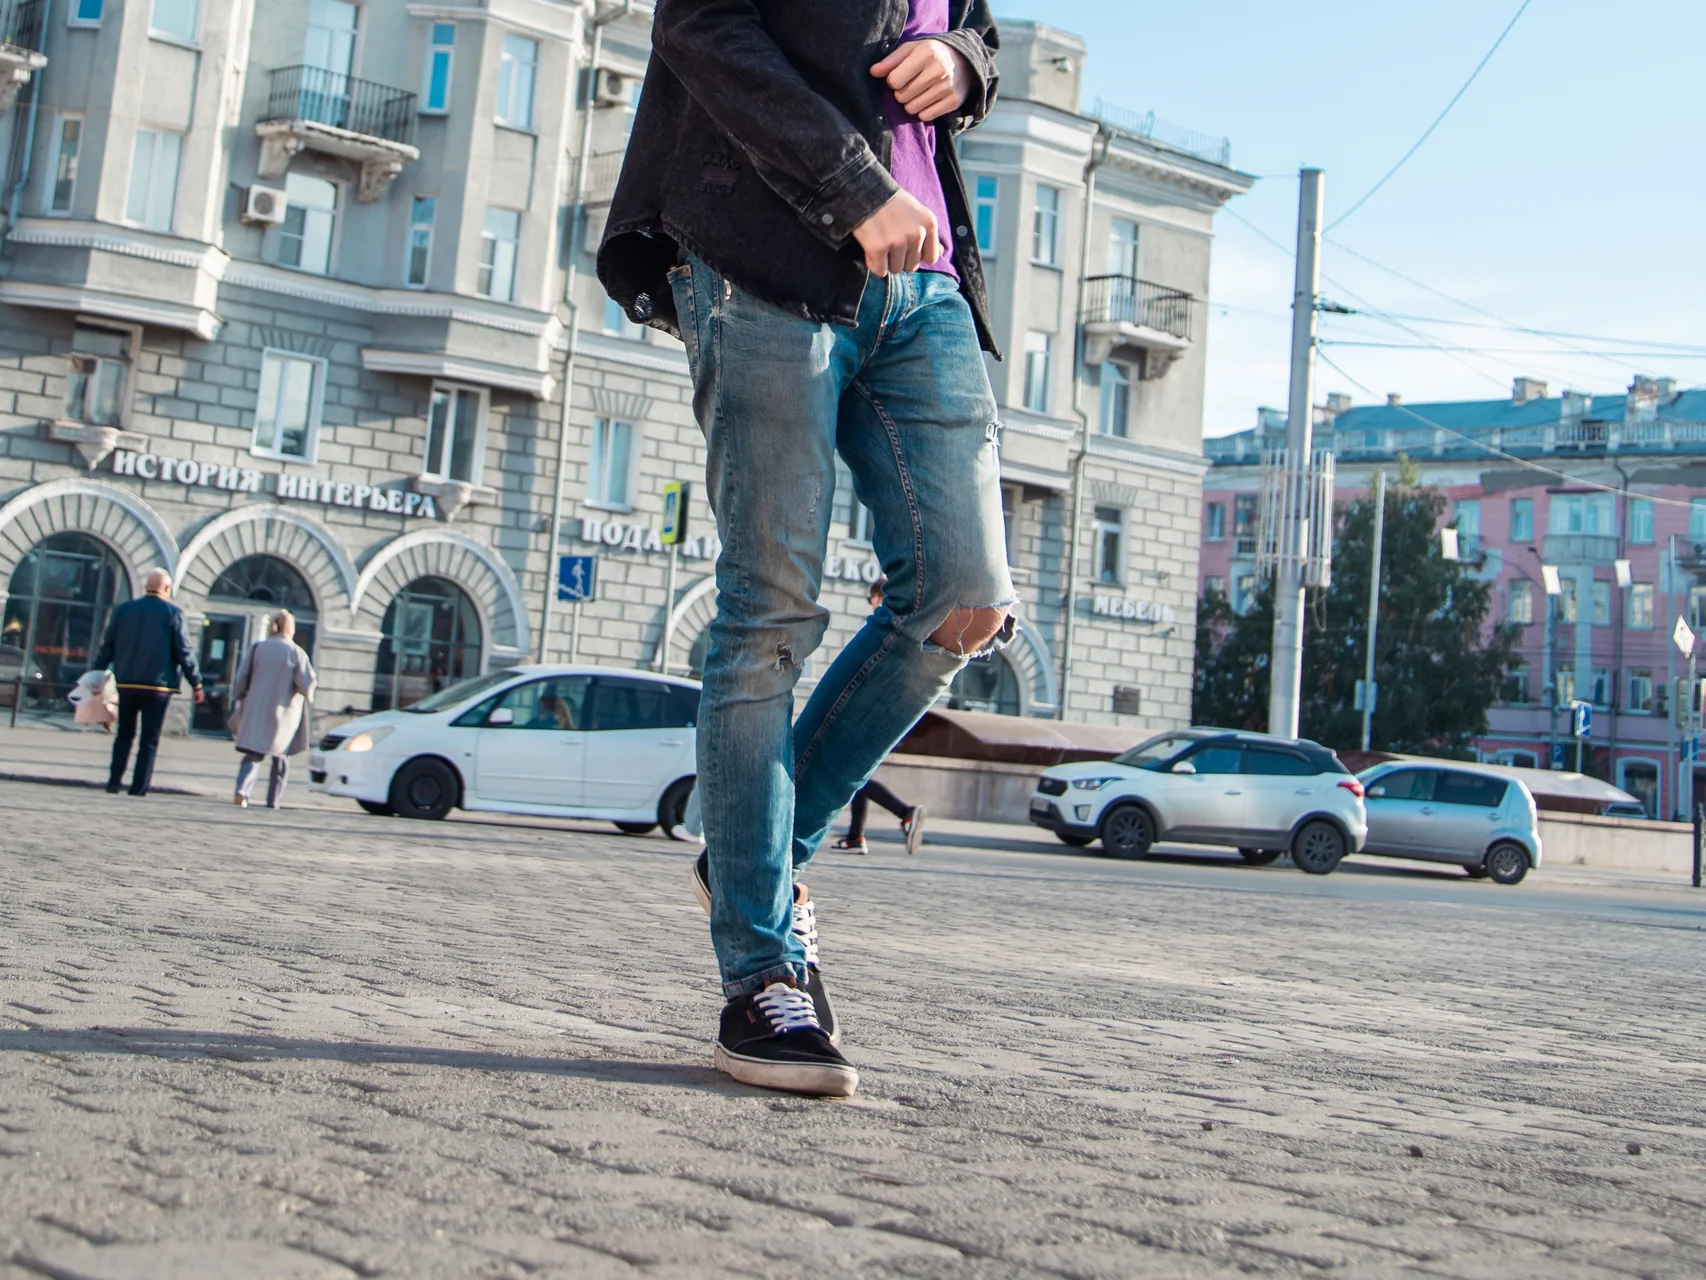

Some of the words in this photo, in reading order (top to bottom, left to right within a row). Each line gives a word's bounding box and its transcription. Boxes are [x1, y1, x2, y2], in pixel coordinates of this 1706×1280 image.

[113, 449, 264, 492] ИСТОРИЯ
[276, 473, 436, 518] ИНТЕРЬЕРА
[582, 519, 721, 559] ПОДАКИ
[824, 554, 881, 583] ЕКО
[1093, 595, 1175, 622] МЕБЕЛЬ
